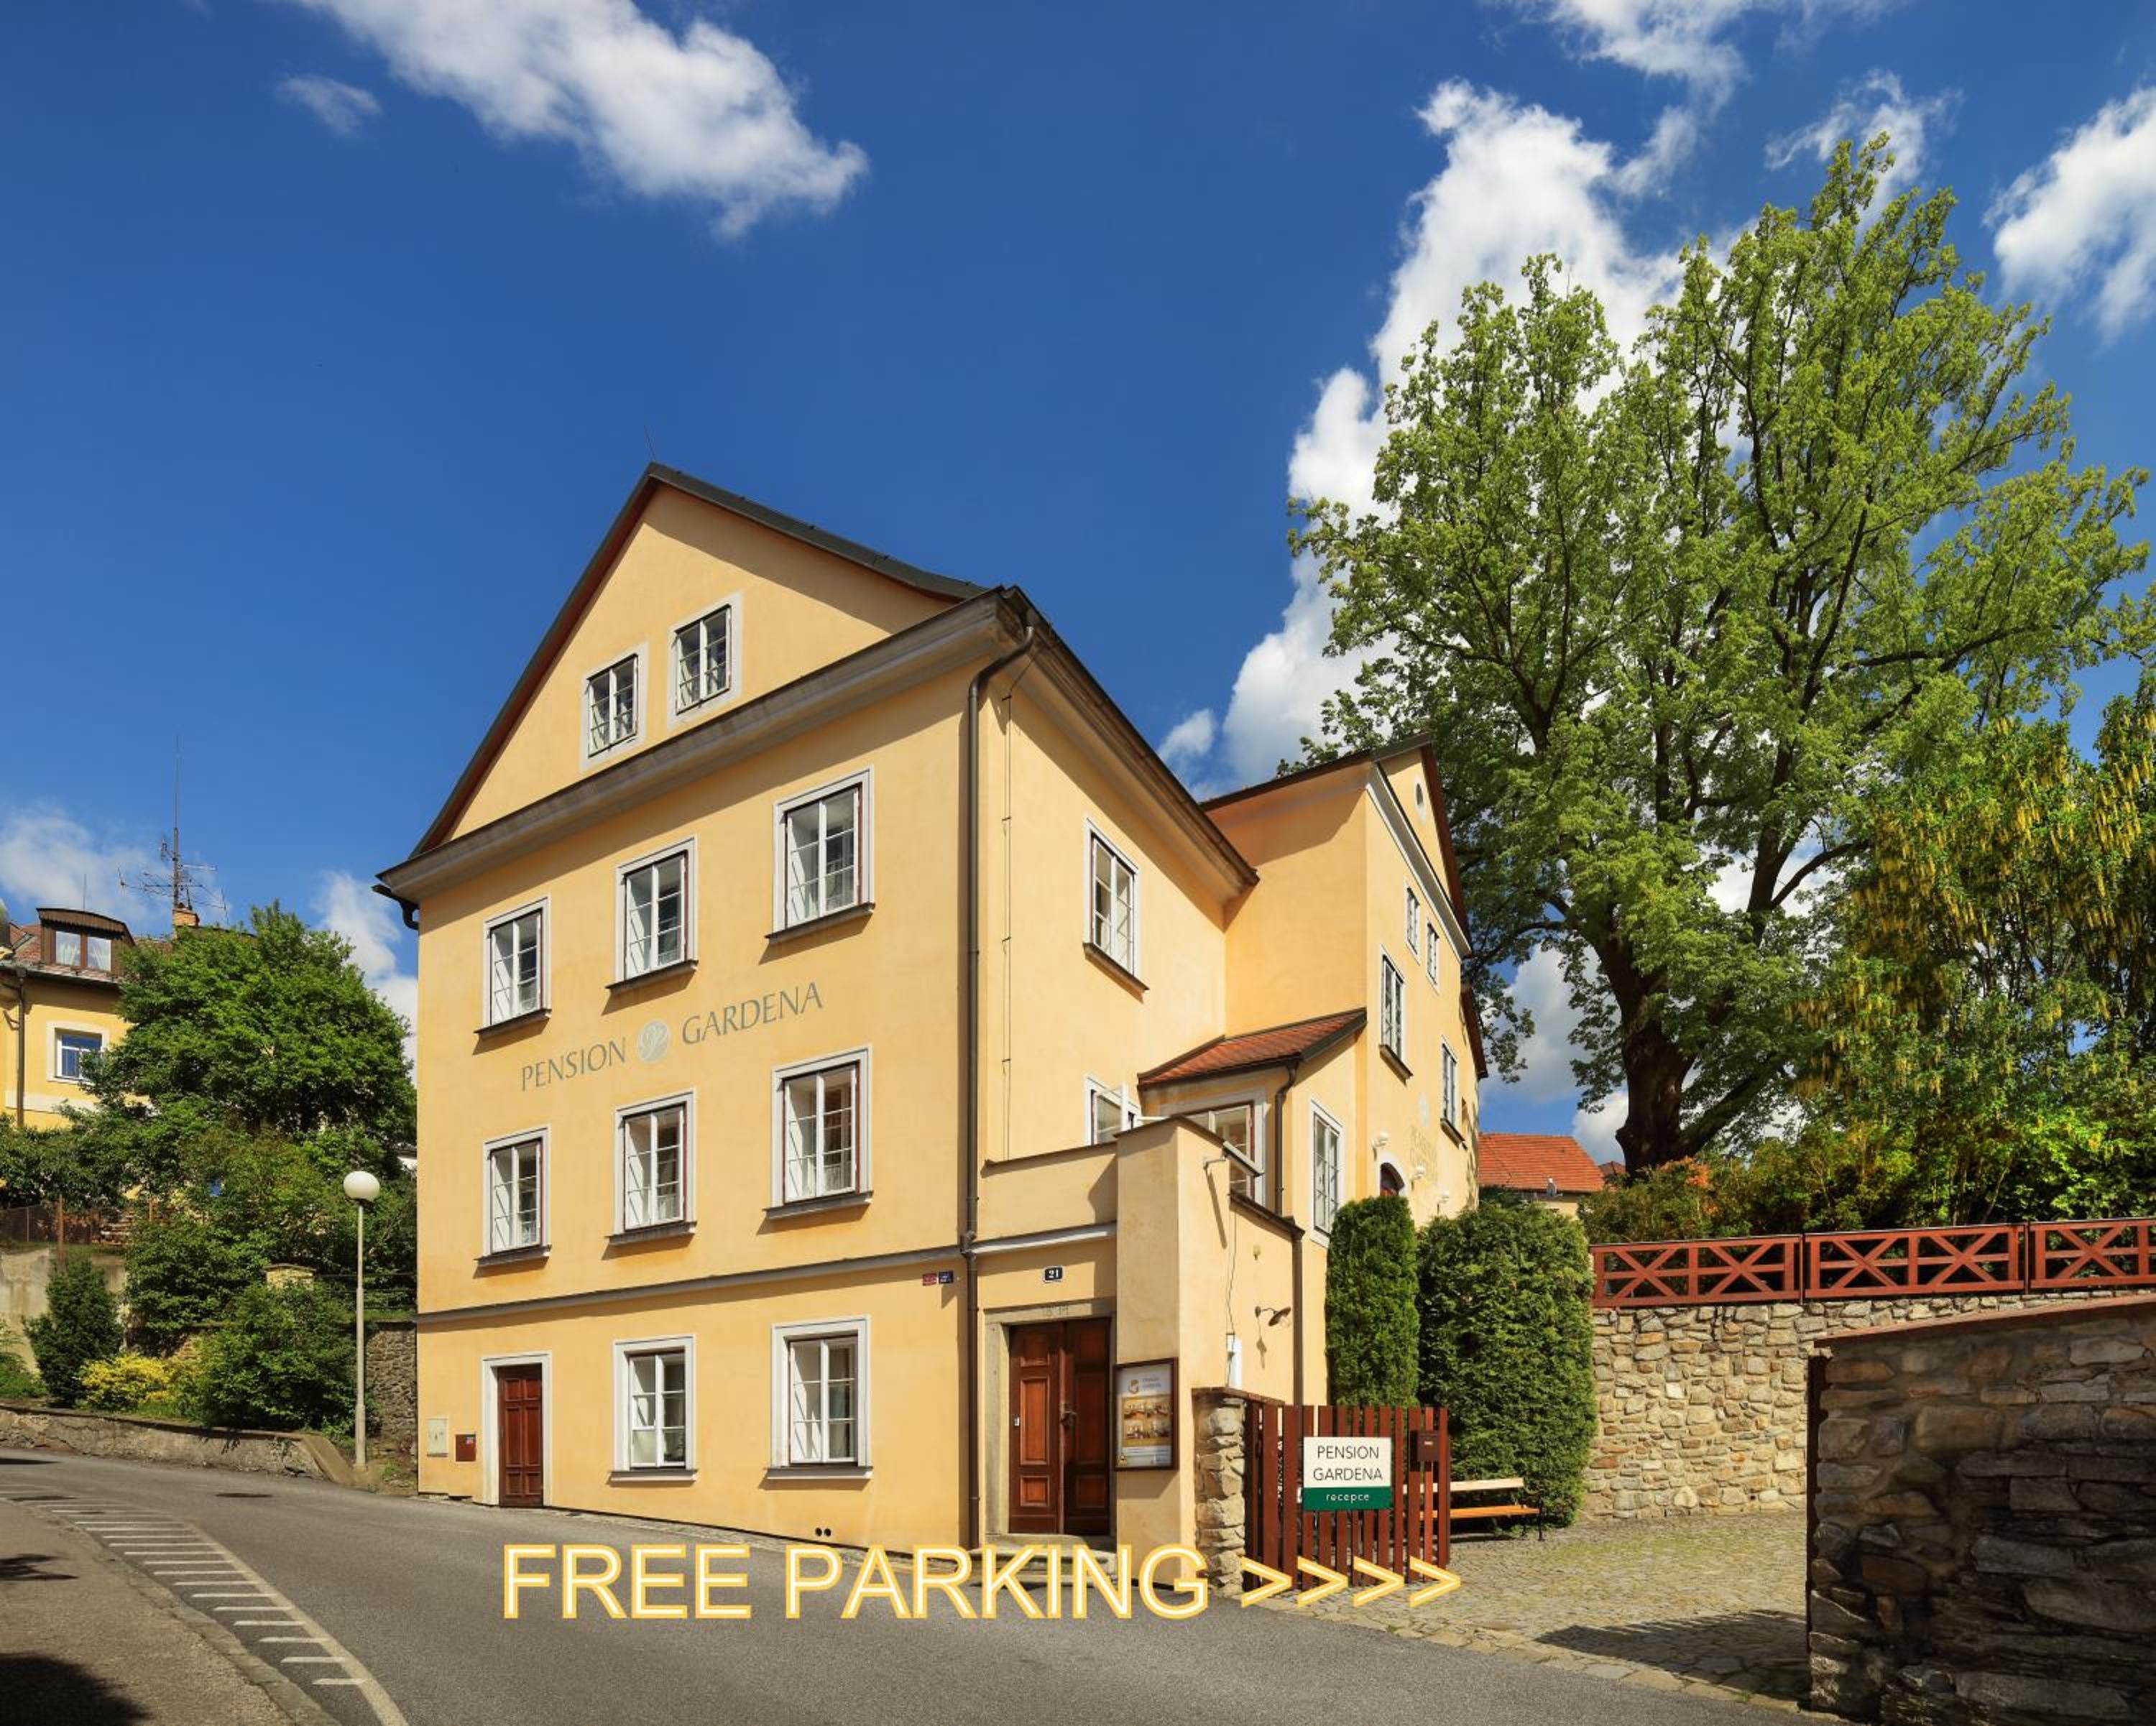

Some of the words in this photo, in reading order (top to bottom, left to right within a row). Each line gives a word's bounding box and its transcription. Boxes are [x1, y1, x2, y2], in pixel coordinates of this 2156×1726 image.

[521, 1037, 627, 1092] PENSION
[681, 982, 824, 1045] GARDENA
[1049, 1269, 1059, 1278] 21
[1317, 1446, 1379, 1459] PENSION
[1313, 1468, 1383, 1480] GARDENA
[1326, 1494, 1369, 1504] recepce
